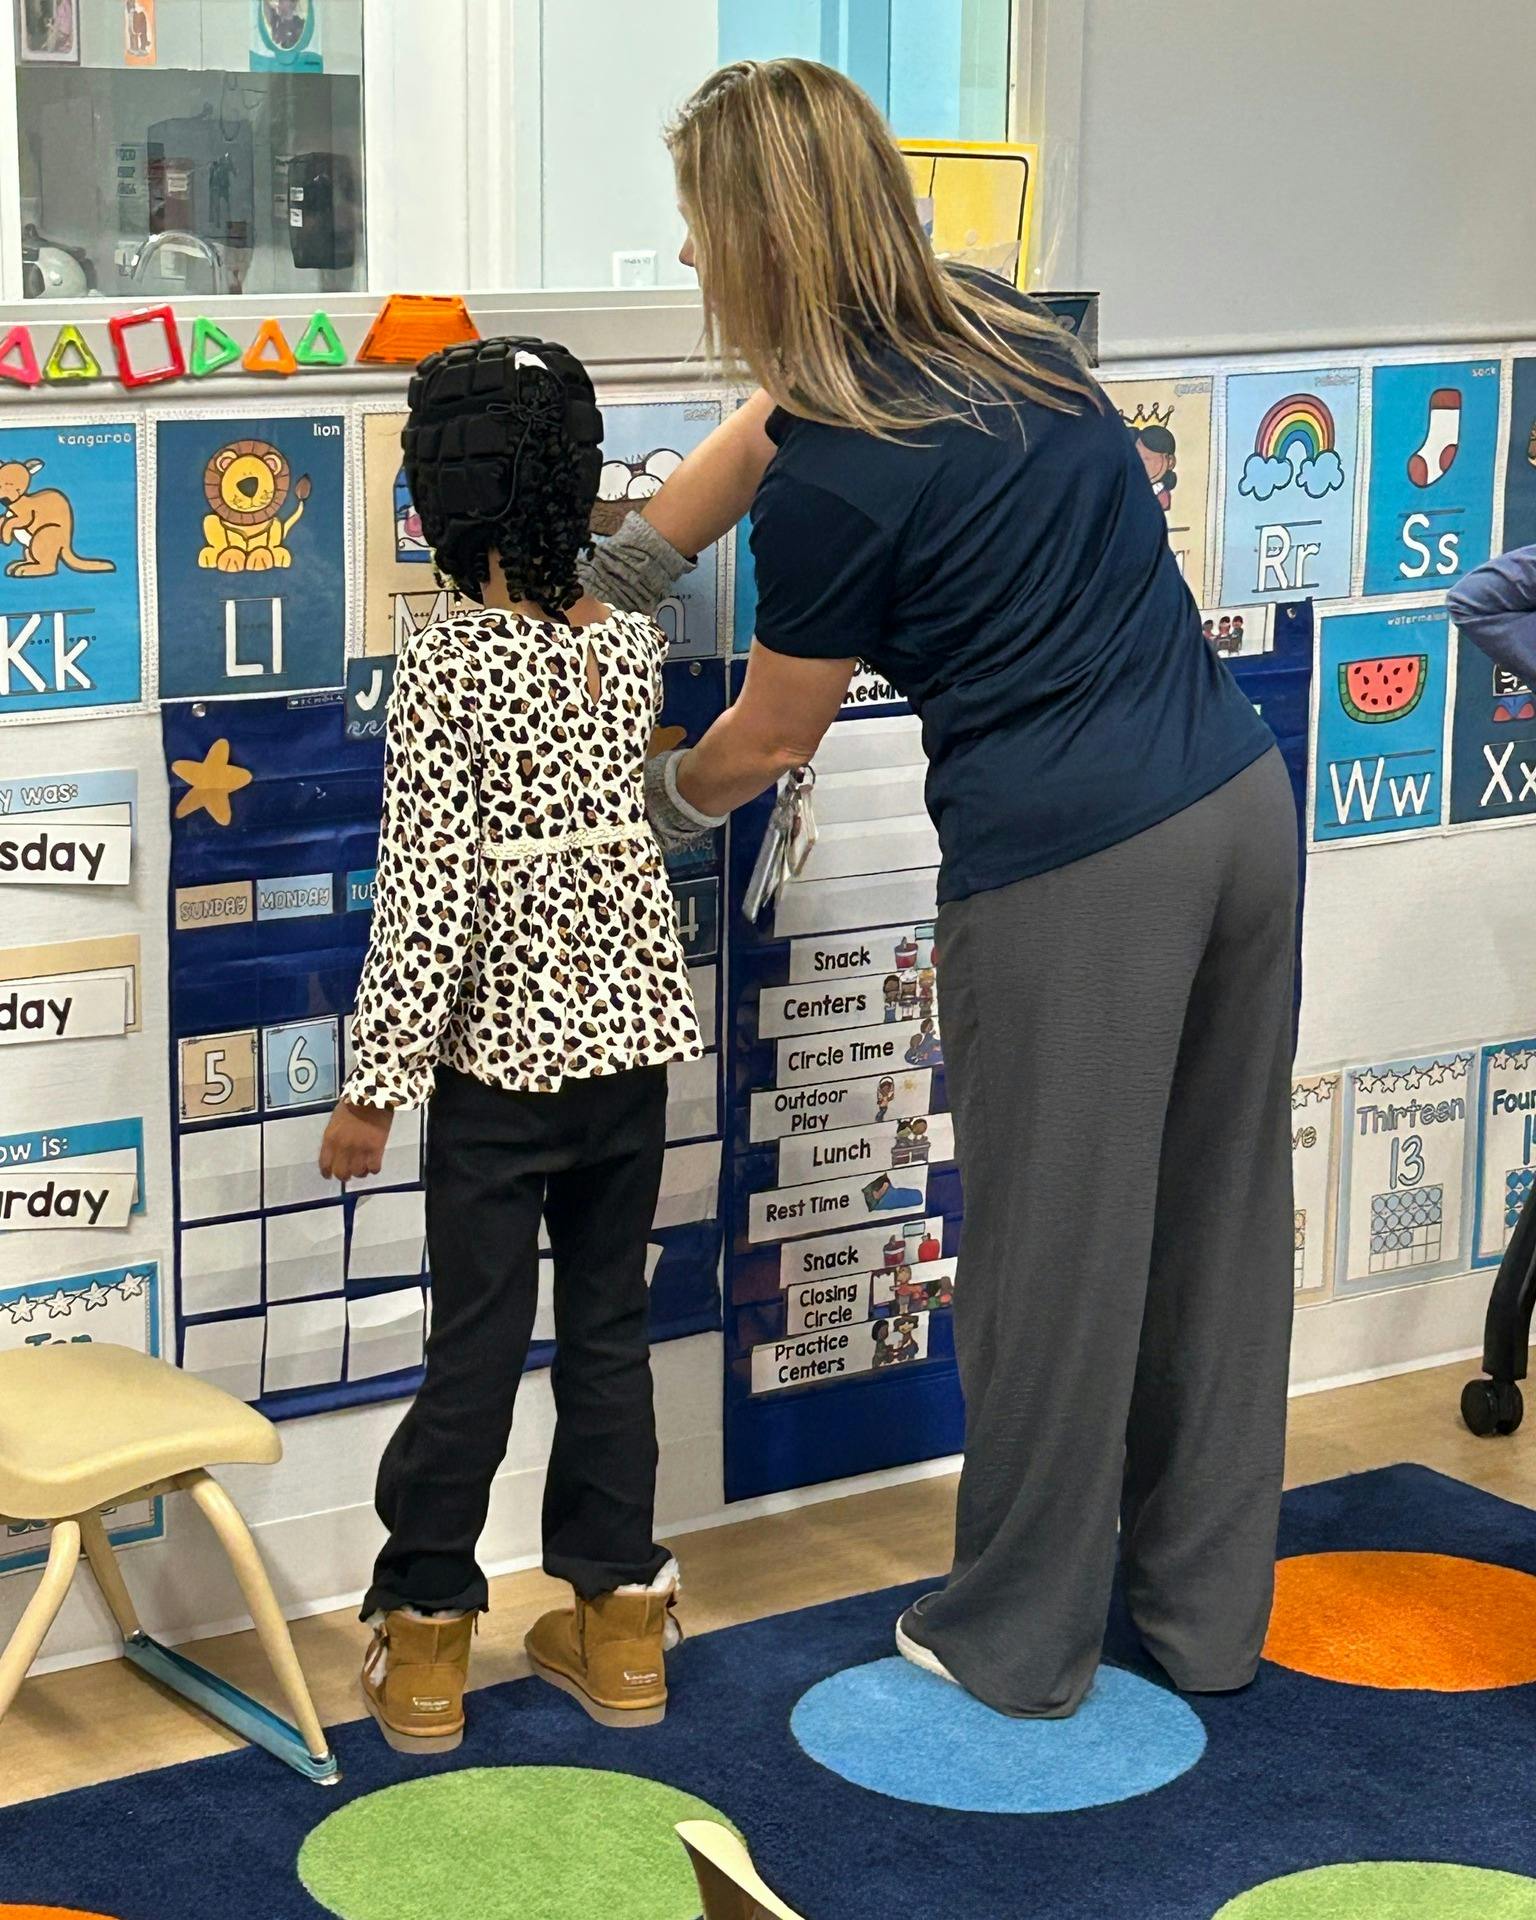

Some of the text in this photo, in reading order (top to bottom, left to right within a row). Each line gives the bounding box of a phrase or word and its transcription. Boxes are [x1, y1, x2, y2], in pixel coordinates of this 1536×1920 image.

[57, 432, 132, 447] kangaroo
[313, 423, 341, 437] lion
[1257, 524, 1320, 593] Rr
[1399, 513, 1459, 579] Ss
[0, 612, 92, 695] Kk
[1480, 741, 1536, 806] Xx
[21, 783, 79, 806] was:
[1329, 756, 1431, 824] Ww
[0, 832, 106, 881] sday
[180, 896, 248, 922] SUNDAY
[259, 887, 330, 911] MONDAY
[814, 946, 871, 972] Snack
[0, 992, 73, 1036] day
[783, 994, 867, 1020] Centers
[286, 1035, 319, 1094] 6
[788, 1041, 895, 1071] Circle Time
[200, 1049, 234, 1106] 5
[775, 1089, 848, 1111] Outdoor
[791, 1113, 830, 1132] Play
[1356, 1096, 1466, 1136] Thirteen
[42, 1136, 68, 1158] is:
[813, 1138, 871, 1167] Lunch
[1523, 1113, 1536, 1166] 1
[1389, 1134, 1425, 1190] 13
[0, 1181, 109, 1225] rday
[765, 1193, 850, 1223] Rest Time
[802, 1245, 859, 1273] Snack
[800, 1284, 858, 1308] Closing
[803, 1306, 853, 1329] Circle
[775, 1333, 849, 1362] Practice
[778, 1357, 846, 1384] Centers
